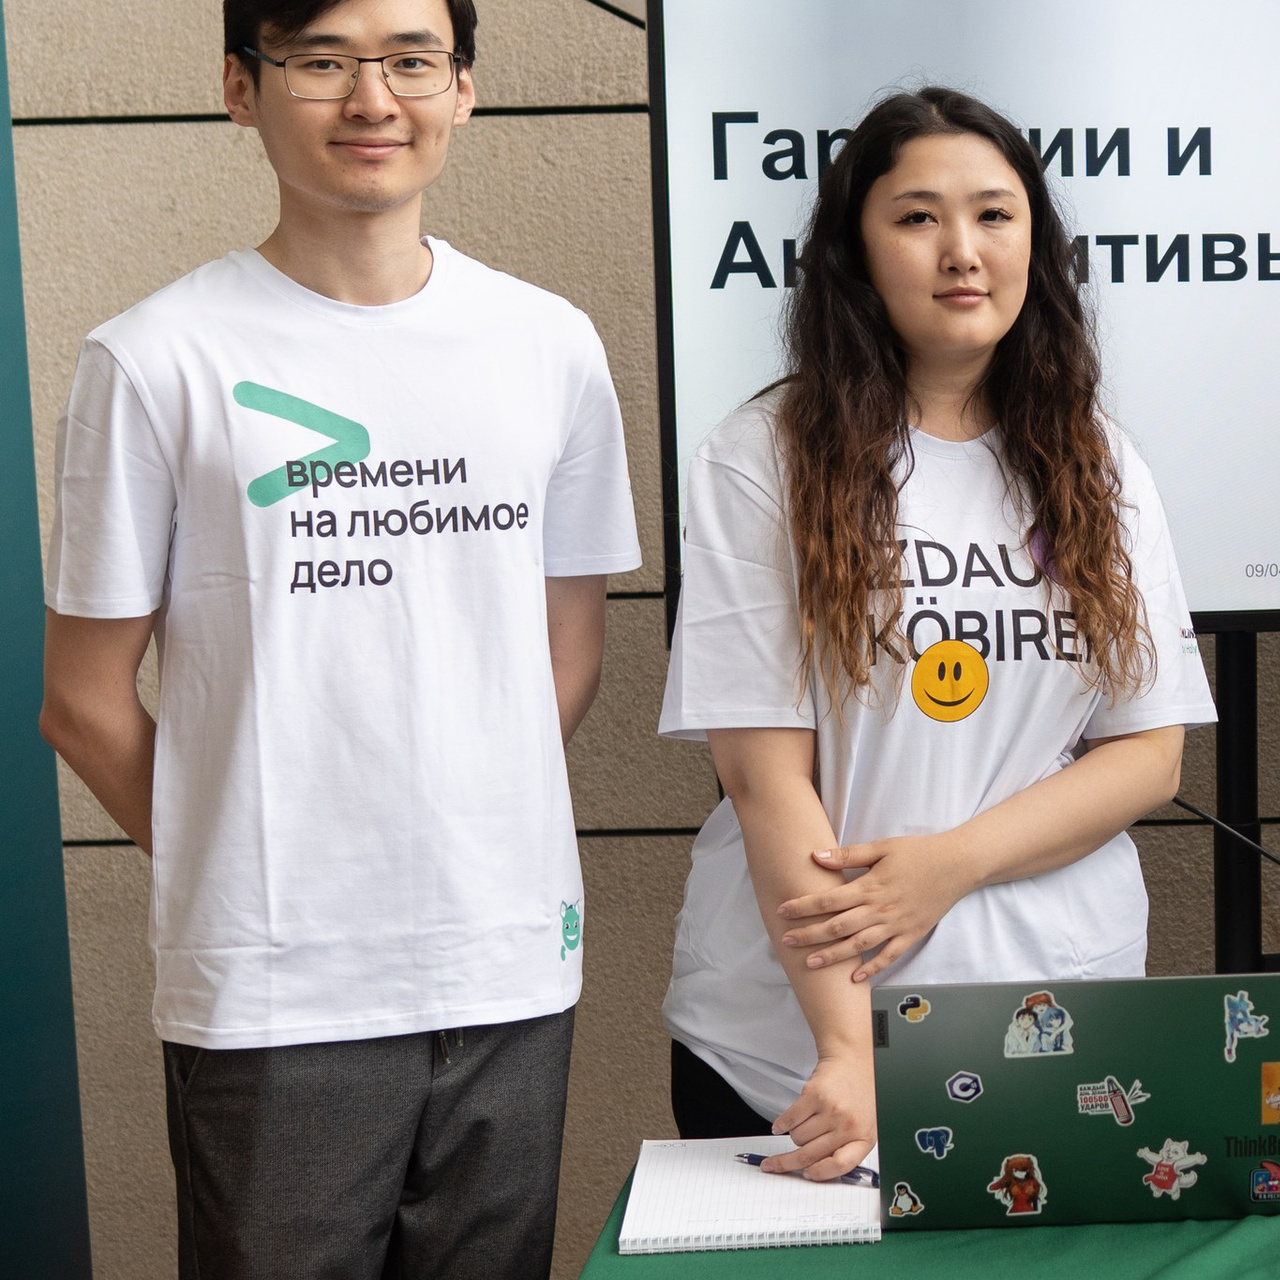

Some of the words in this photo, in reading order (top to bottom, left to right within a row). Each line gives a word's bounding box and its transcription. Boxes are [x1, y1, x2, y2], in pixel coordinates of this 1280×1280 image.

[1167, 126, 1212, 176] и
[285, 457, 467, 498] времени
[290, 509, 337, 537] на
[347, 499, 529, 537] любимое
[290, 558, 393, 593] дело
[1080, 1095, 1109, 1104] 100500
[1080, 1103, 1110, 1111] УДАРОВ
